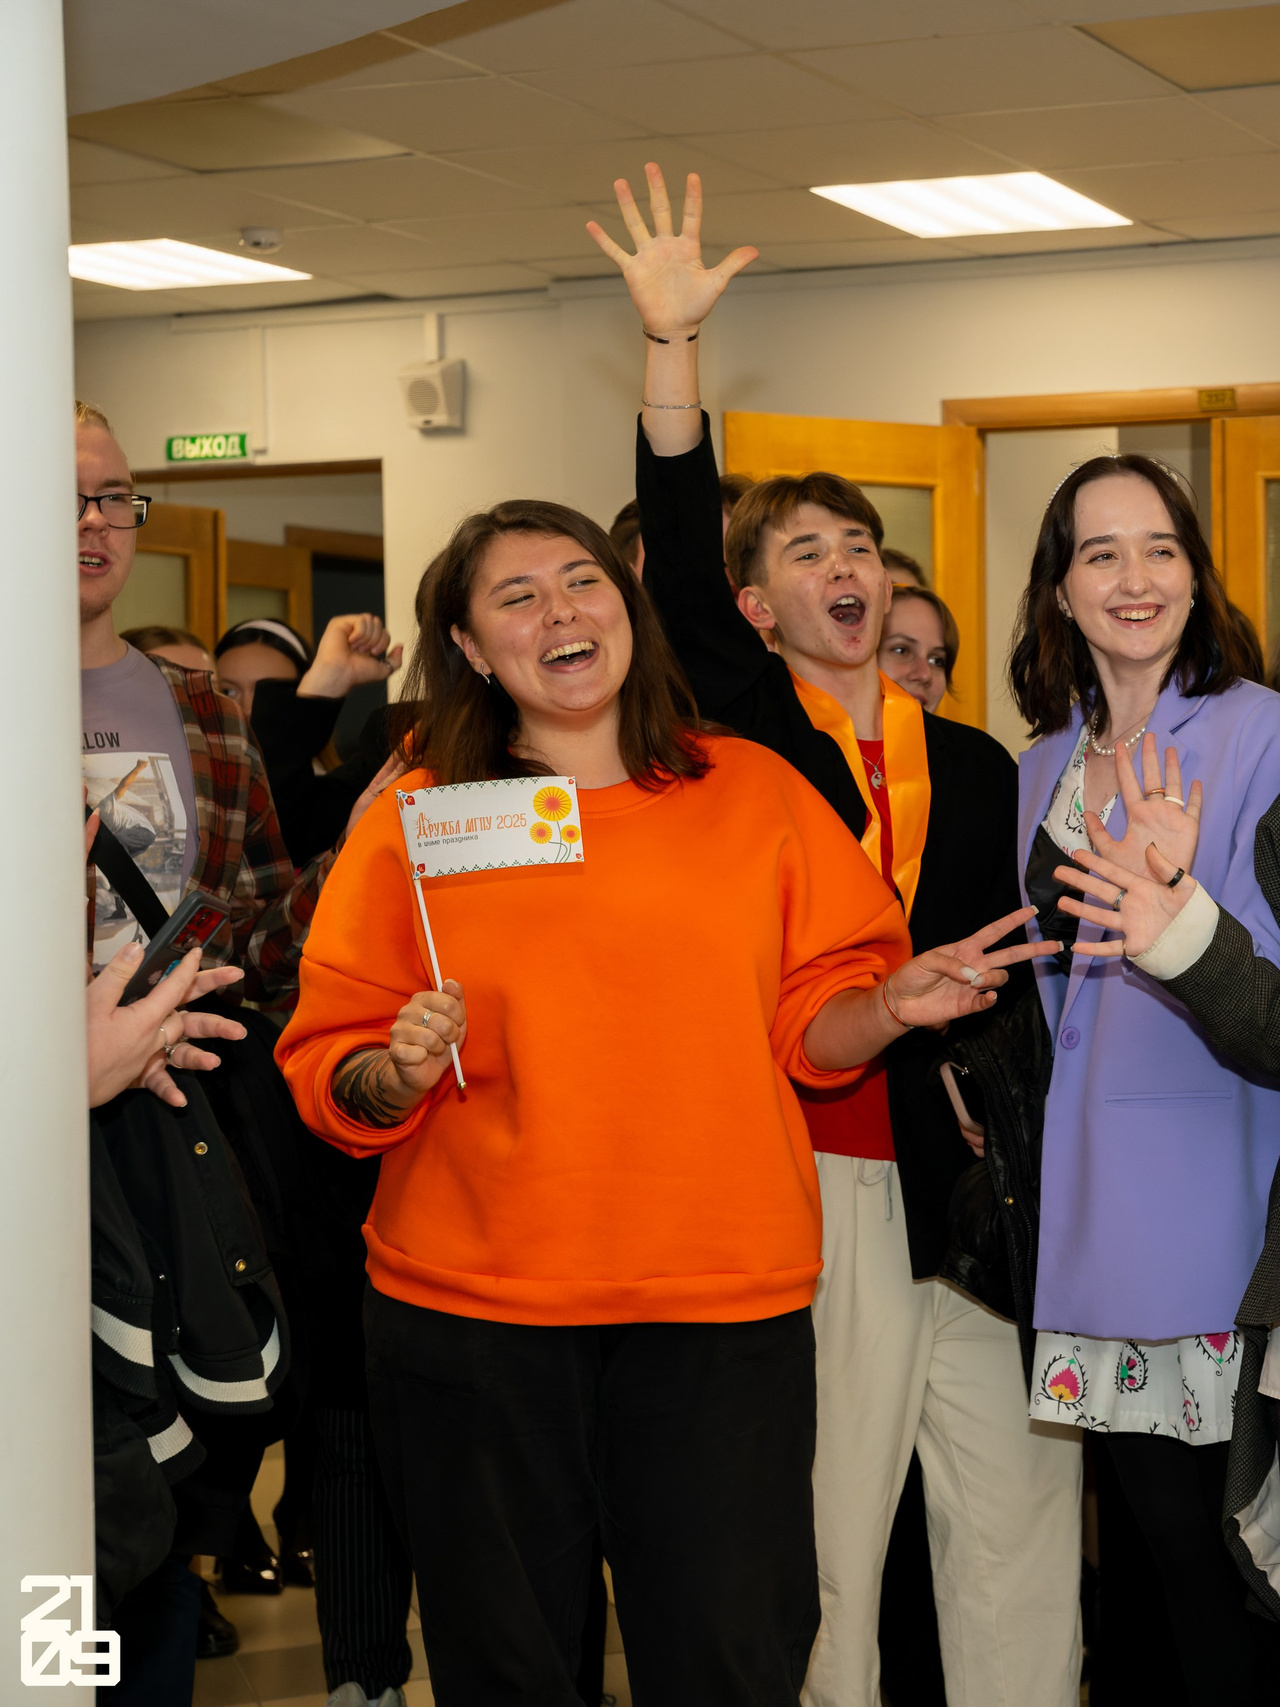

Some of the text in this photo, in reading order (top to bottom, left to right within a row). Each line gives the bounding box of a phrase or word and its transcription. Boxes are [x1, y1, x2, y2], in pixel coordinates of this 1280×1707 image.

[171, 434, 242, 460] ВЫХОД
[83, 731, 120, 750] LOW
[464, 815, 492, 834] МГПУ
[496, 812, 527, 830] 2025
[424, 839, 441, 848] шуме
[442, 833, 479, 846] праздника
